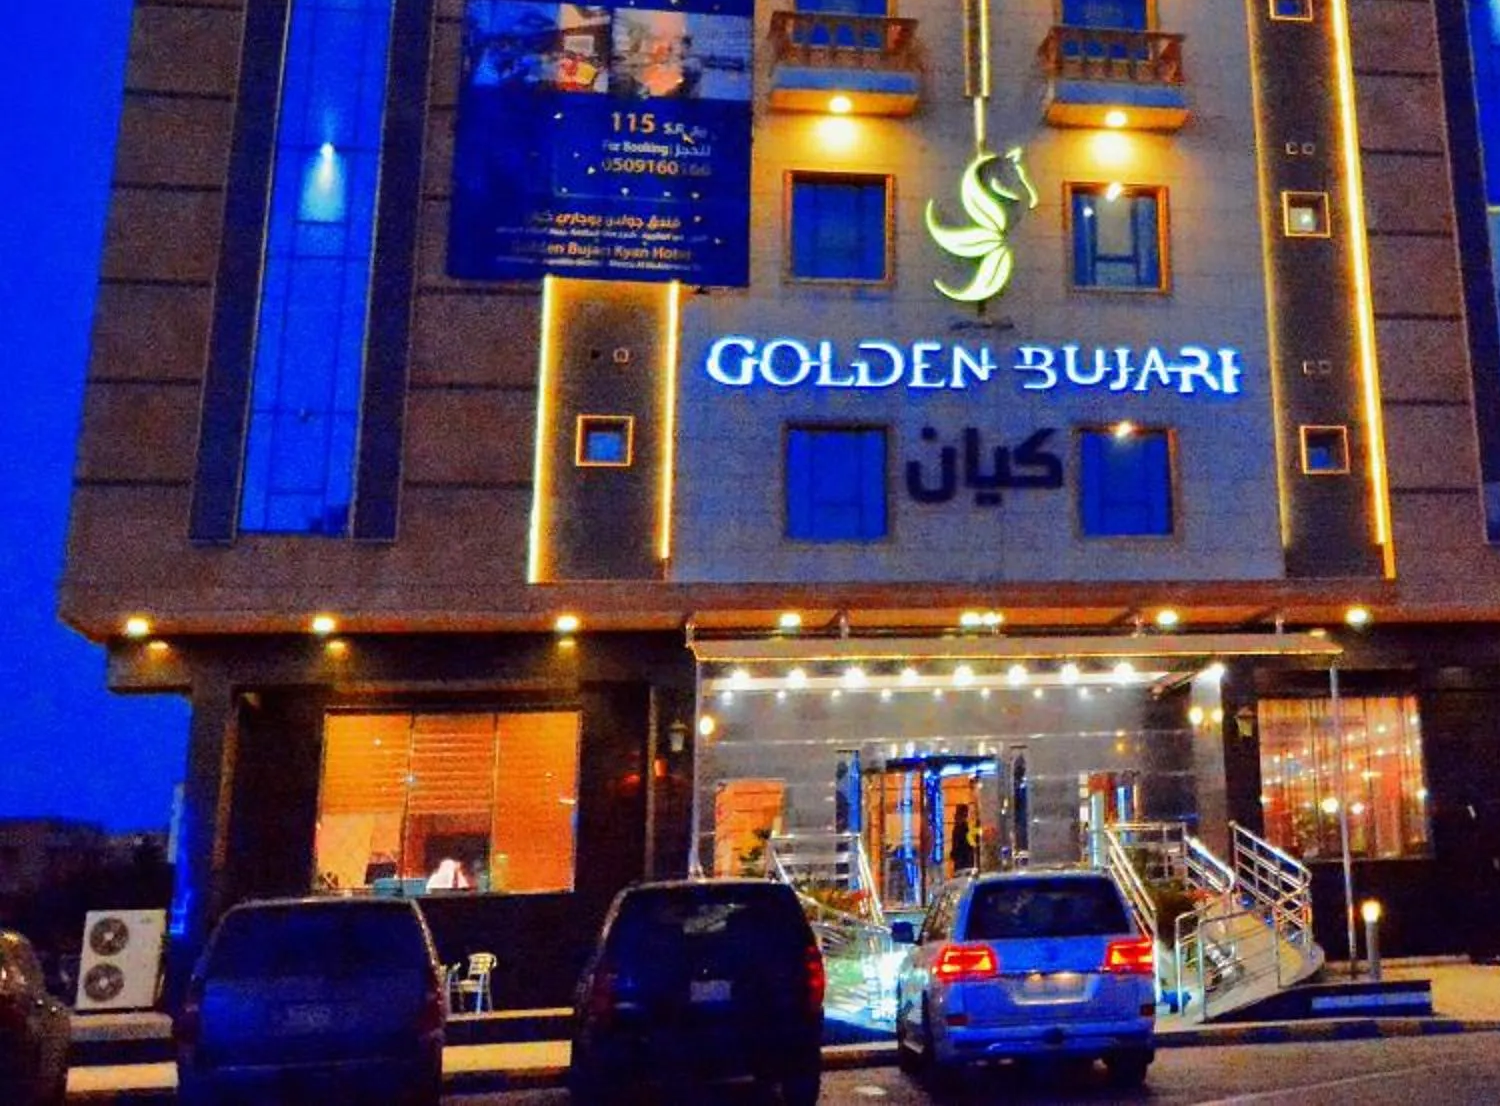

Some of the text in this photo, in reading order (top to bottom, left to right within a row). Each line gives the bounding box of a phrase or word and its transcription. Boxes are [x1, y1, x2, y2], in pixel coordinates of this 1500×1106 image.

[612, 111, 656, 133] 115
[623, 140, 669, 156] Booking
[707, 336, 1241, 393] GOLDEN BUJARI
[906, 427, 1064, 506] كيان
